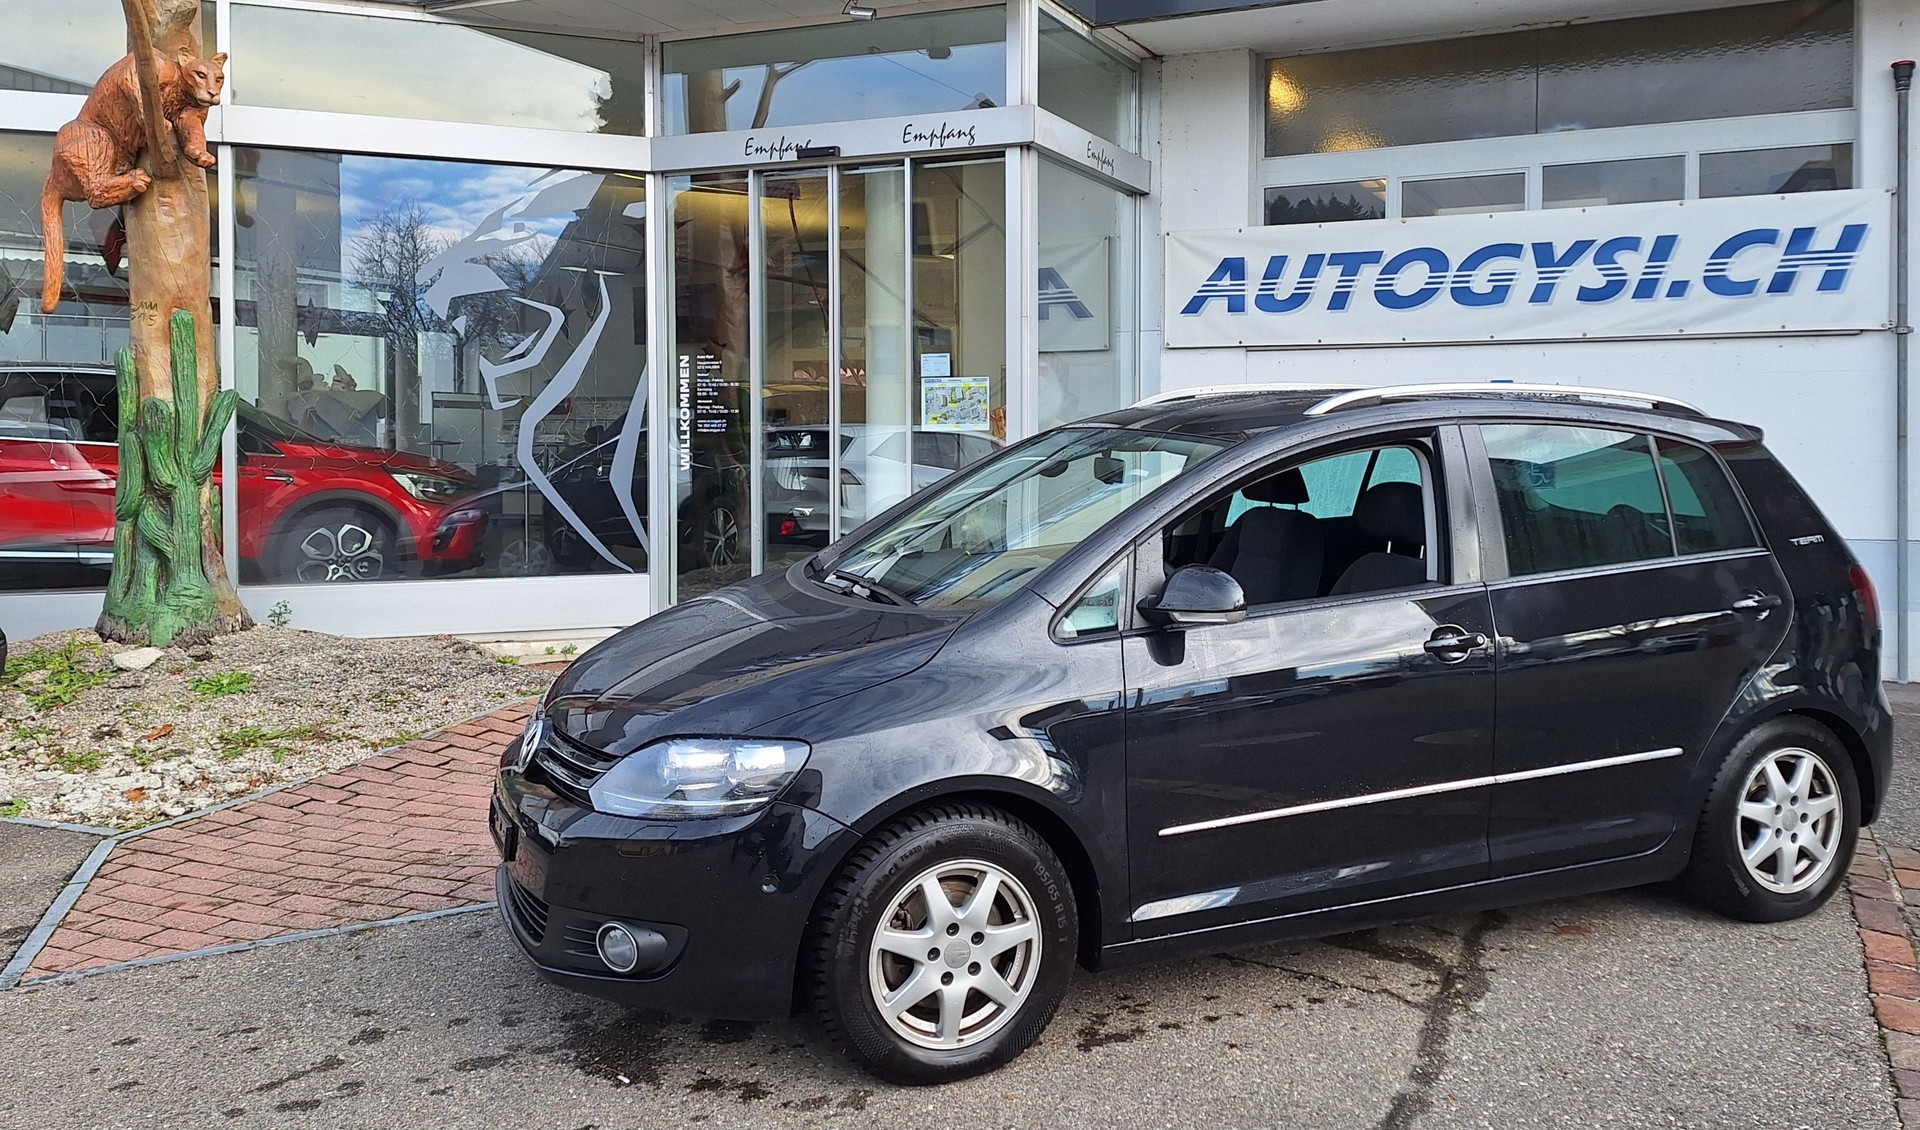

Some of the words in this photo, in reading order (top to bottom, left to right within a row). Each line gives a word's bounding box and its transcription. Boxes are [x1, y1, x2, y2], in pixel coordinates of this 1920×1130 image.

[903, 121, 976, 146] Empfang
[1086, 140, 1115, 175] Empfang
[1178, 223, 1871, 316] AUTOGYSI.CH
[680, 355, 690, 471] WILLKOMMEN
[1788, 534, 1825, 547] TEAM
[1033, 862, 1061, 901] 195/65
